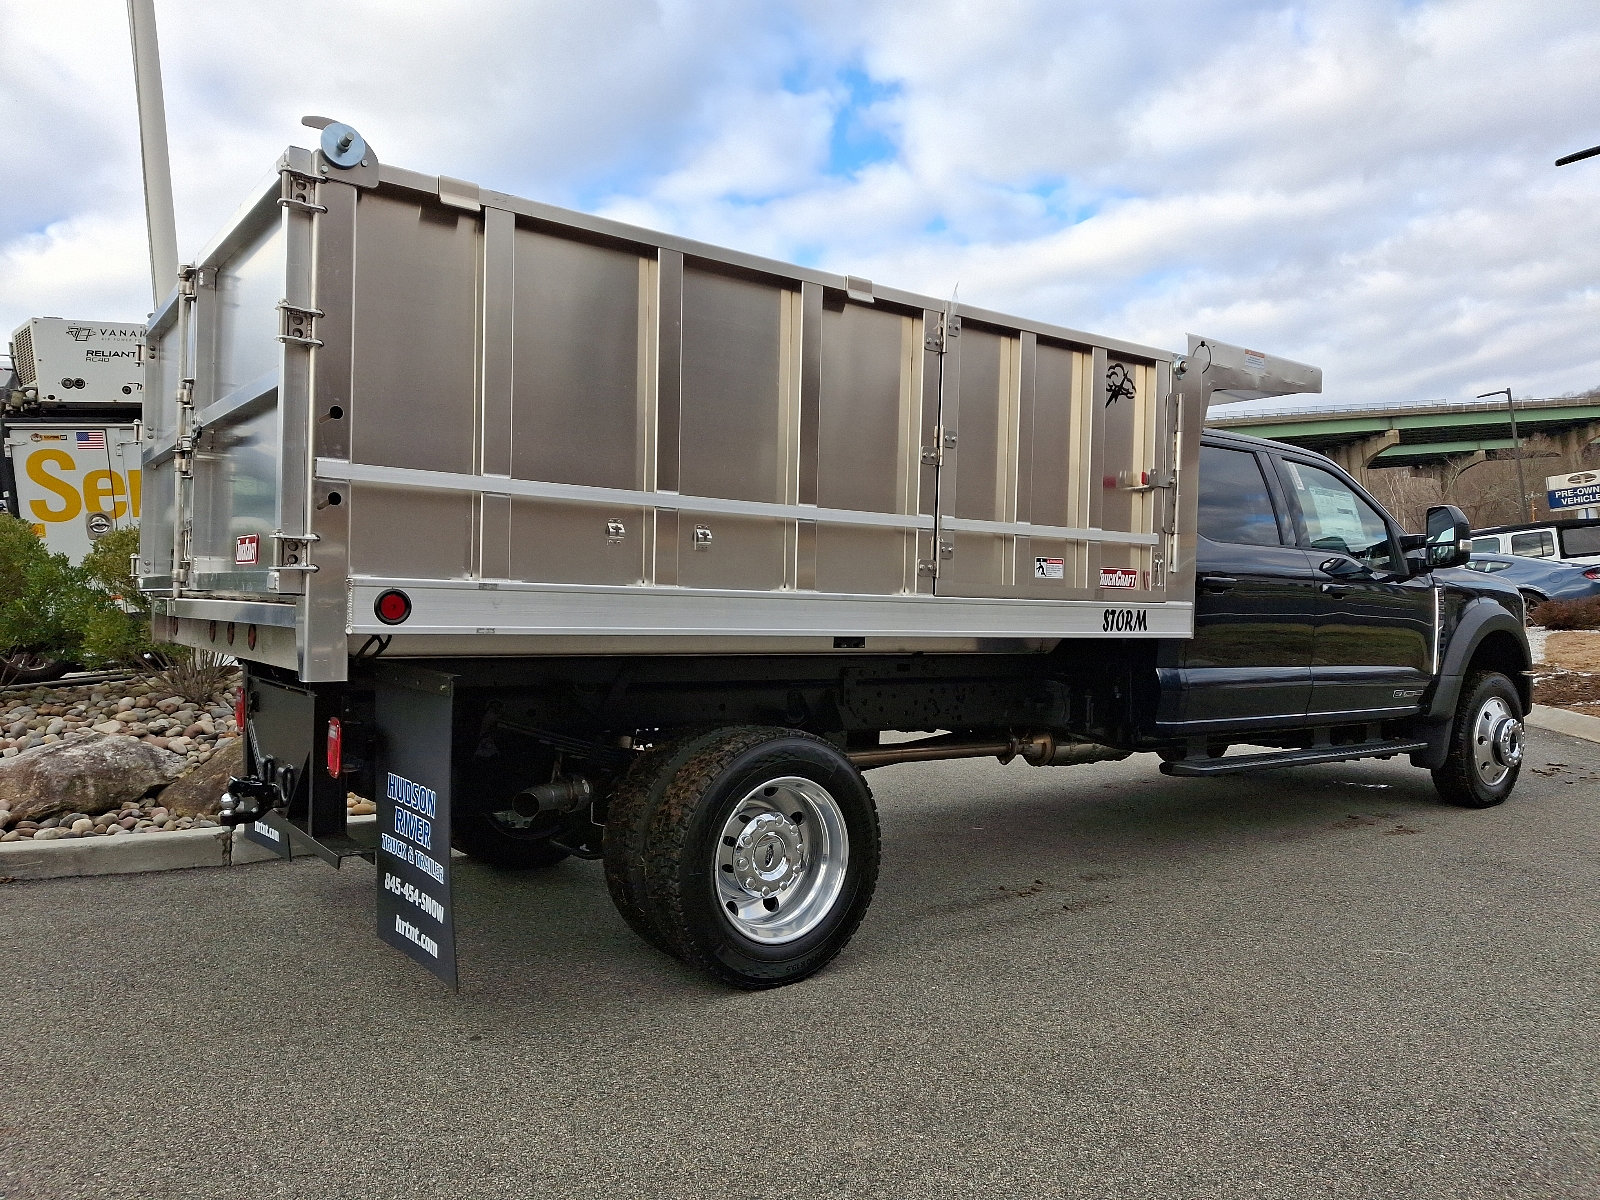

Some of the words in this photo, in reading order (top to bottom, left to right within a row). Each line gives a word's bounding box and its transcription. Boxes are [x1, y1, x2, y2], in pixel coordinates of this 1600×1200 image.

[86, 350, 136, 358] RELIANT
[100, 329, 147, 337] VANAI
[1102, 609, 1147, 632] STORM
[386, 771, 437, 820] HUDSON
[394, 805, 431, 850] RIVER
[381, 833, 407, 861] TRUCK
[407, 845, 415, 865] &
[415, 850, 444, 885] TRAILER
[384, 872, 444, 924] 845-454-SNOW
[395, 914, 438, 959] hrtnt.com
